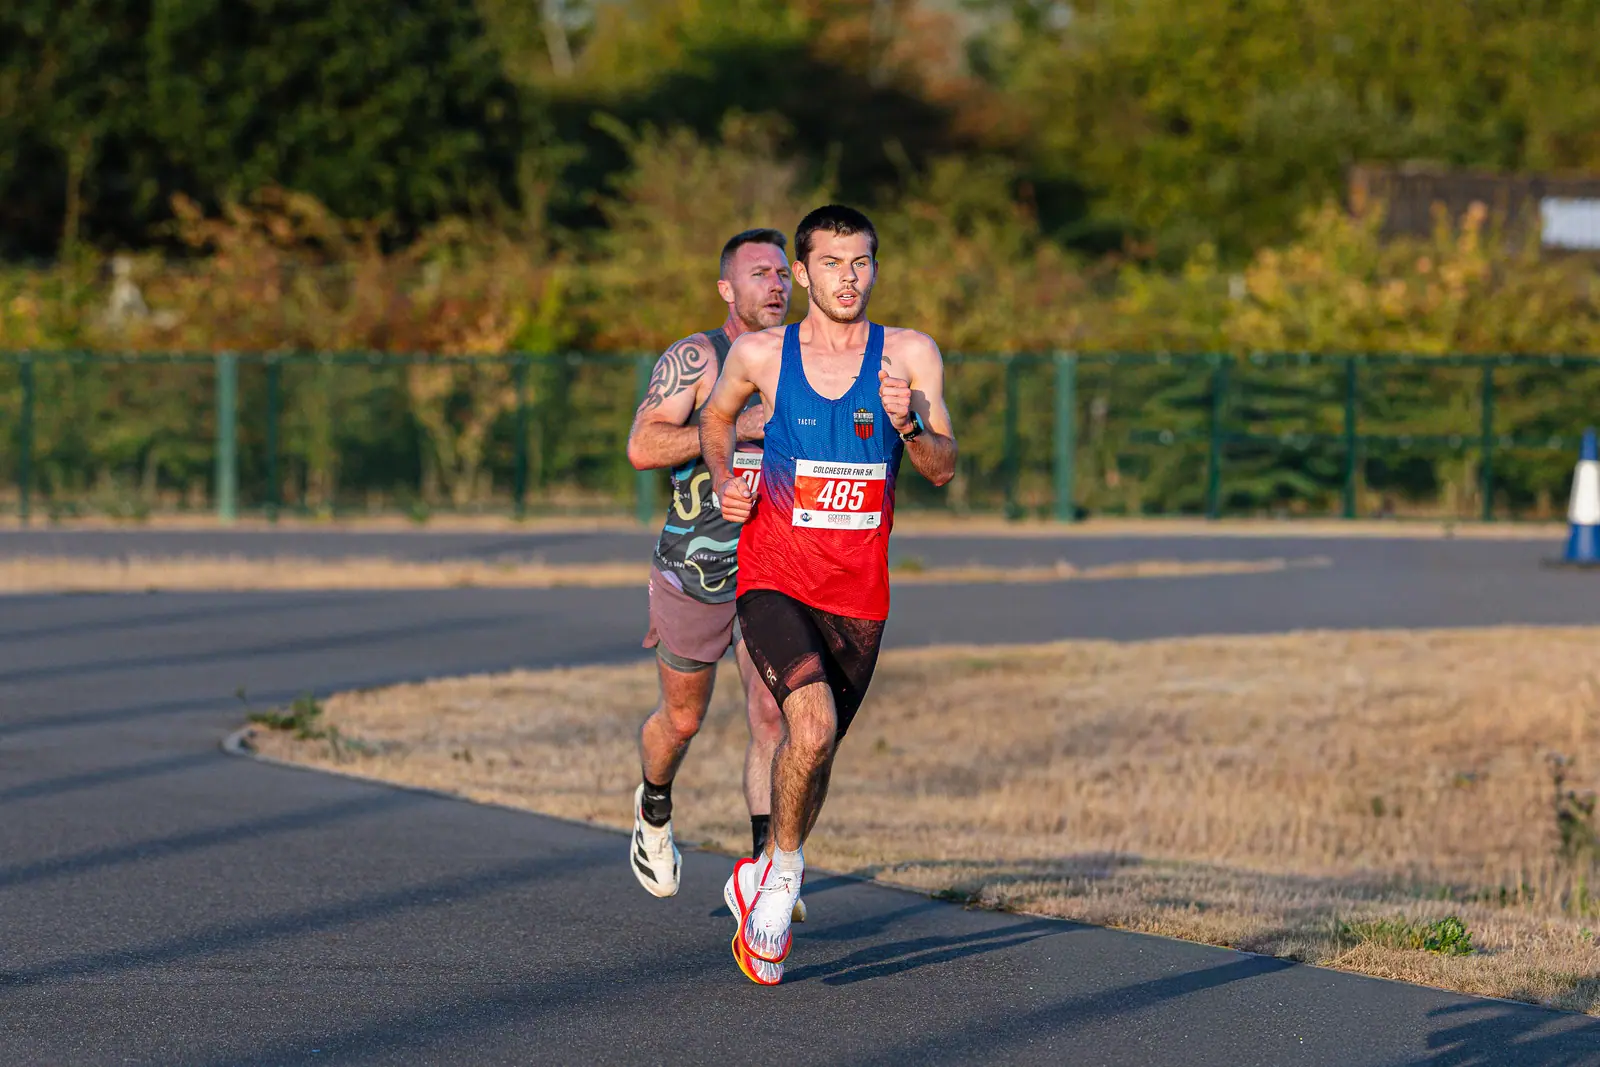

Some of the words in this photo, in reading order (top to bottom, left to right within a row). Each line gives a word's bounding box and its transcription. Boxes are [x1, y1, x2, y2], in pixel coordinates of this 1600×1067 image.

[813, 465, 852, 476] COLCHESTER
[852, 468, 865, 476] FNR
[865, 468, 874, 477] 5K
[816, 480, 867, 511] 485
